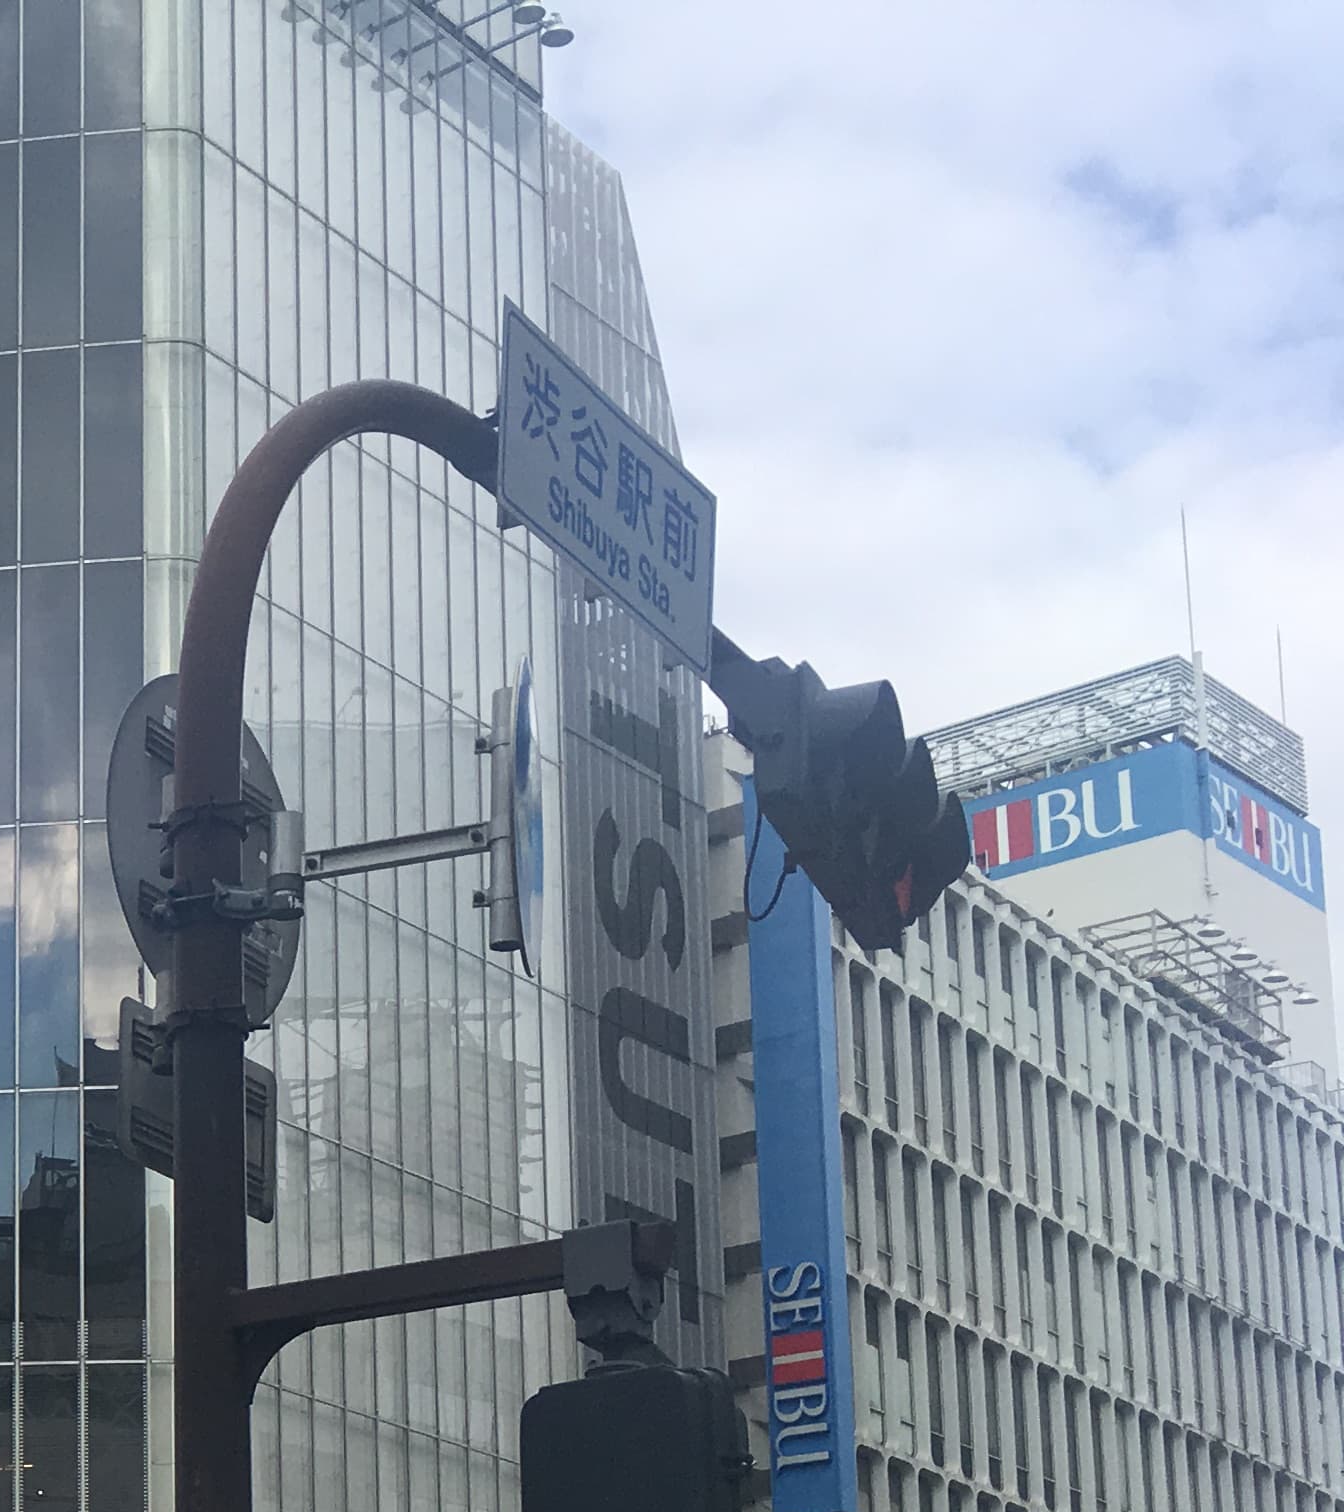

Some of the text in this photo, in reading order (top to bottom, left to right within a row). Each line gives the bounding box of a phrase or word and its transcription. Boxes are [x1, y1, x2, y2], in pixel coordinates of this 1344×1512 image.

[522, 352, 699, 582] 渋谷駅前
[548, 476, 676, 623] Shibuya Sta.
[996, 769, 1142, 865] IBU
[1211, 774, 1315, 893] SEIBU
[768, 1261, 837, 1475] SEIBU
